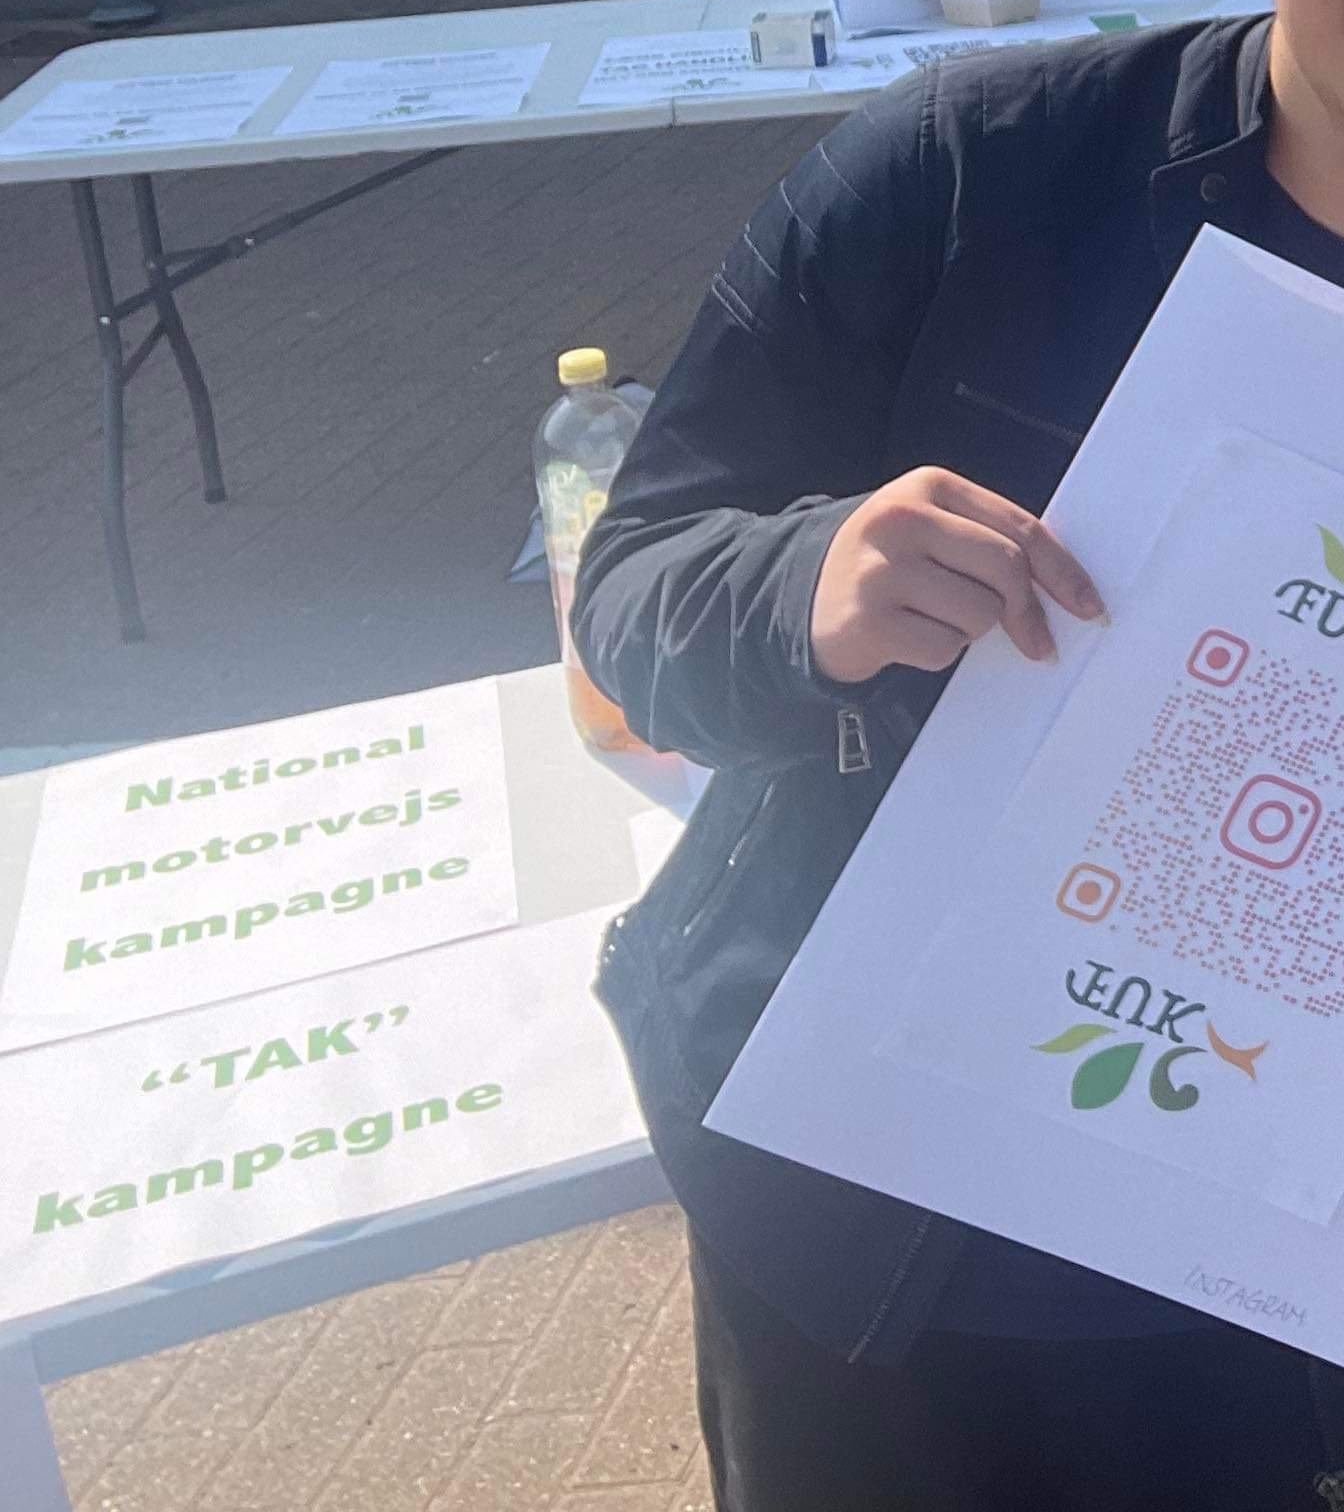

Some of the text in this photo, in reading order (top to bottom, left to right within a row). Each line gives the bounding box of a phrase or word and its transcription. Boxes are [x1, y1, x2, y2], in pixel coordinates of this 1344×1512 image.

[124, 724, 427, 814] National
[79, 787, 463, 892] motorvejs
[62, 855, 471, 973] kampagne
[140, 1004, 411, 1093] “TAK”
[32, 1082, 504, 1235] kampagne
[1183, 1264, 1308, 1326] INSTAGRAM
